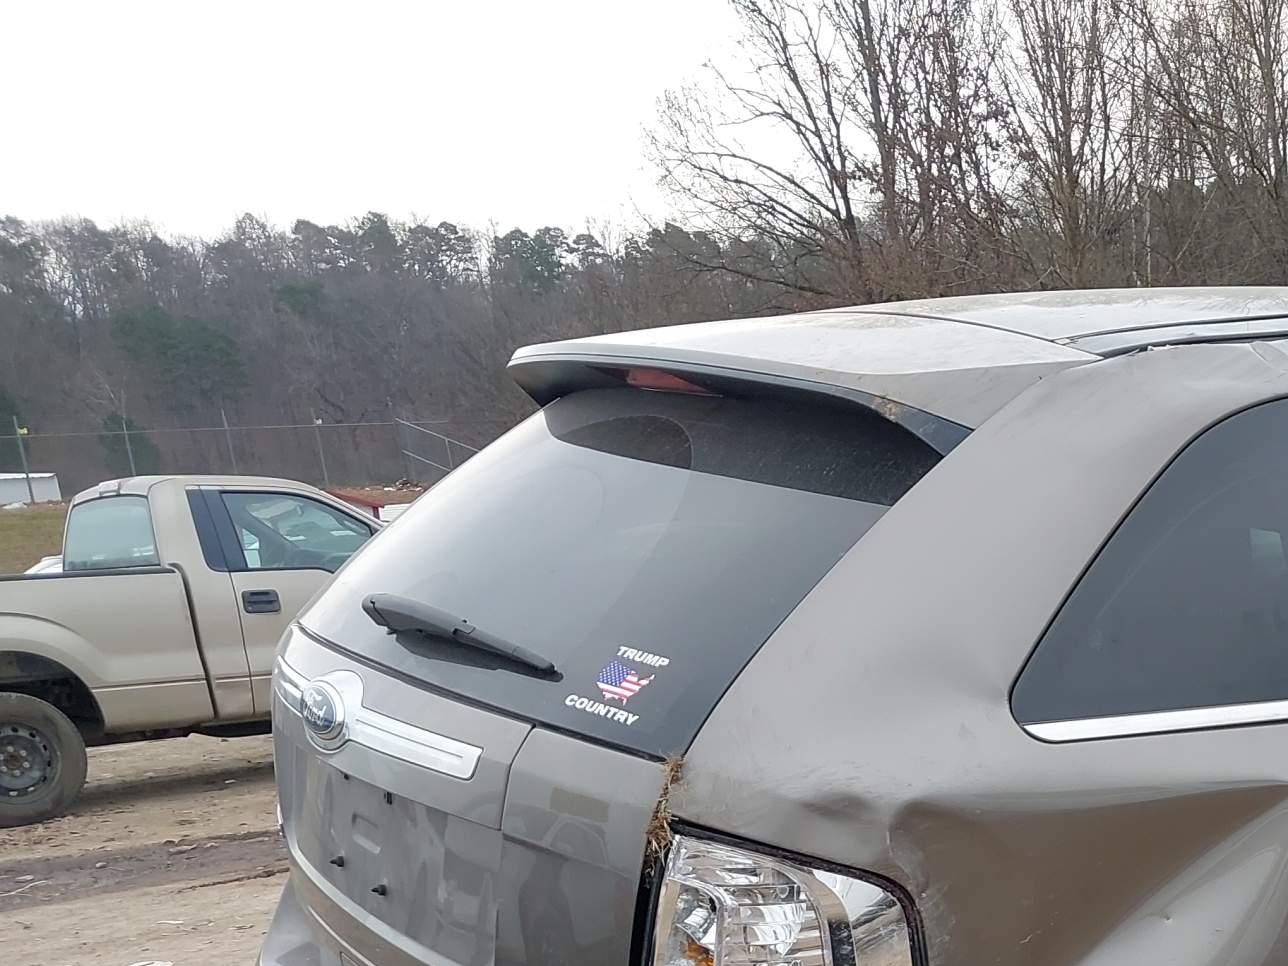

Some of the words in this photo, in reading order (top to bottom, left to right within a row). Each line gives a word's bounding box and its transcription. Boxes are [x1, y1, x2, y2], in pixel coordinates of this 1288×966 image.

[617, 646, 670, 667] TRUMP
[304, 688, 327, 726] Ford
[564, 694, 640, 726] COUNTRY
